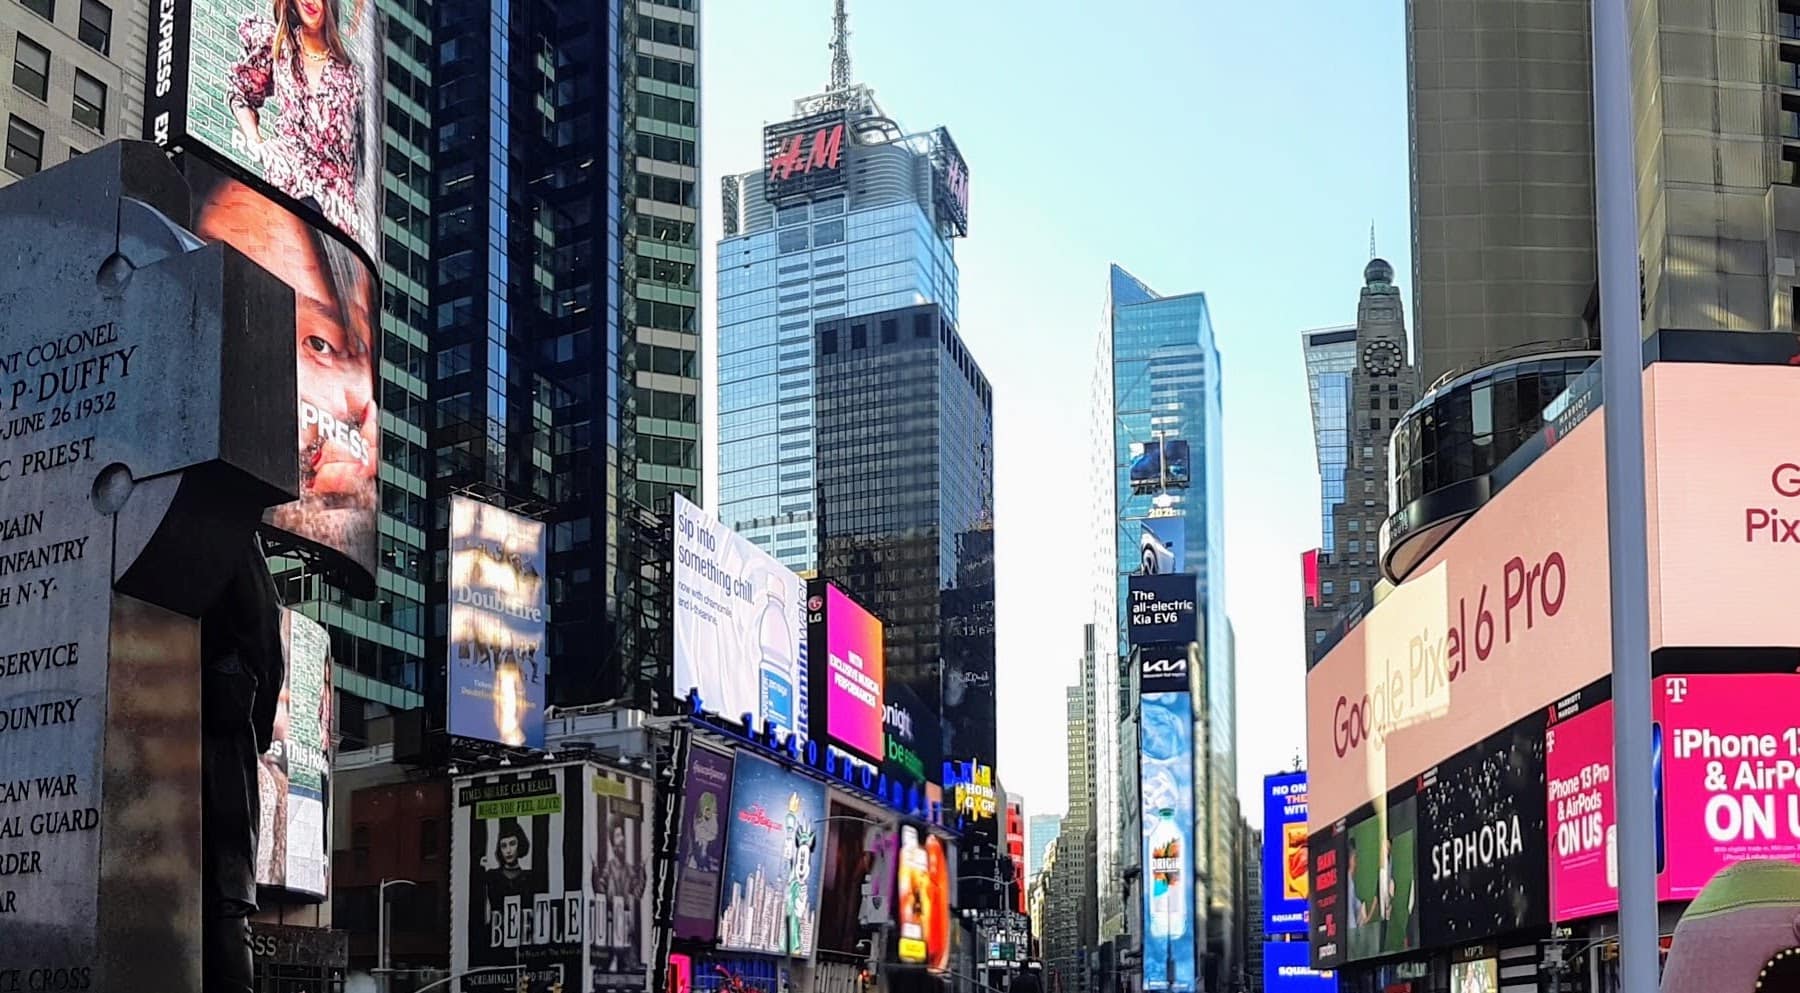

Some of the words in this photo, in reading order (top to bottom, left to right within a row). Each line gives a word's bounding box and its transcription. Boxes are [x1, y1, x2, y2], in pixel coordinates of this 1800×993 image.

[155, 0, 175, 97] EXPRESS
[154, 111, 169, 147] EX
[770, 123, 846, 181] H&M
[26, 322, 118, 367] COLONEL
[51, 403, 71, 427] 26
[75, 391, 117, 419] 1932
[1558, 391, 1592, 425] MARRIOTT
[301, 401, 369, 467] PRESS
[21, 436, 96, 476] PRIEST
[678, 512, 694, 540] sip
[696, 523, 716, 553] into
[678, 545, 732, 597] something
[733, 577, 756, 606] chill.
[457, 583, 542, 623] Doubtfire
[1132, 591, 1155, 601] The
[1132, 600, 1193, 613] all-electric
[809, 614, 822, 623] LG
[1132, 613, 1152, 625] Kia
[1154, 613, 1178, 624] EV6
[1333, 659, 1404, 758] Google
[1410, 598, 1466, 706] Pixel
[1475, 584, 1494, 661] 6
[1504, 552, 1566, 644] Pro
[286, 739, 308, 762] This
[1673, 727, 1777, 759] iPhone
[0, 779, 30, 804] AN
[36, 774, 78, 799] WAR
[1272, 785, 1288, 796] NO
[1548, 773, 1579, 801] iPhone
[1579, 766, 1593, 787] 13
[1592, 762, 1610, 782] Pro
[1704, 761, 1728, 791] &
[30, 807, 100, 836] GUARD
[1557, 802, 1566, 821] &
[1566, 789, 1602, 818] AirPods
[1704, 794, 1777, 841] ON
[1432, 814, 1523, 881] SEPHORA
[1557, 817, 1581, 857] ON
[1581, 812, 1603, 850] US
[29, 967, 91, 993] CROSS
